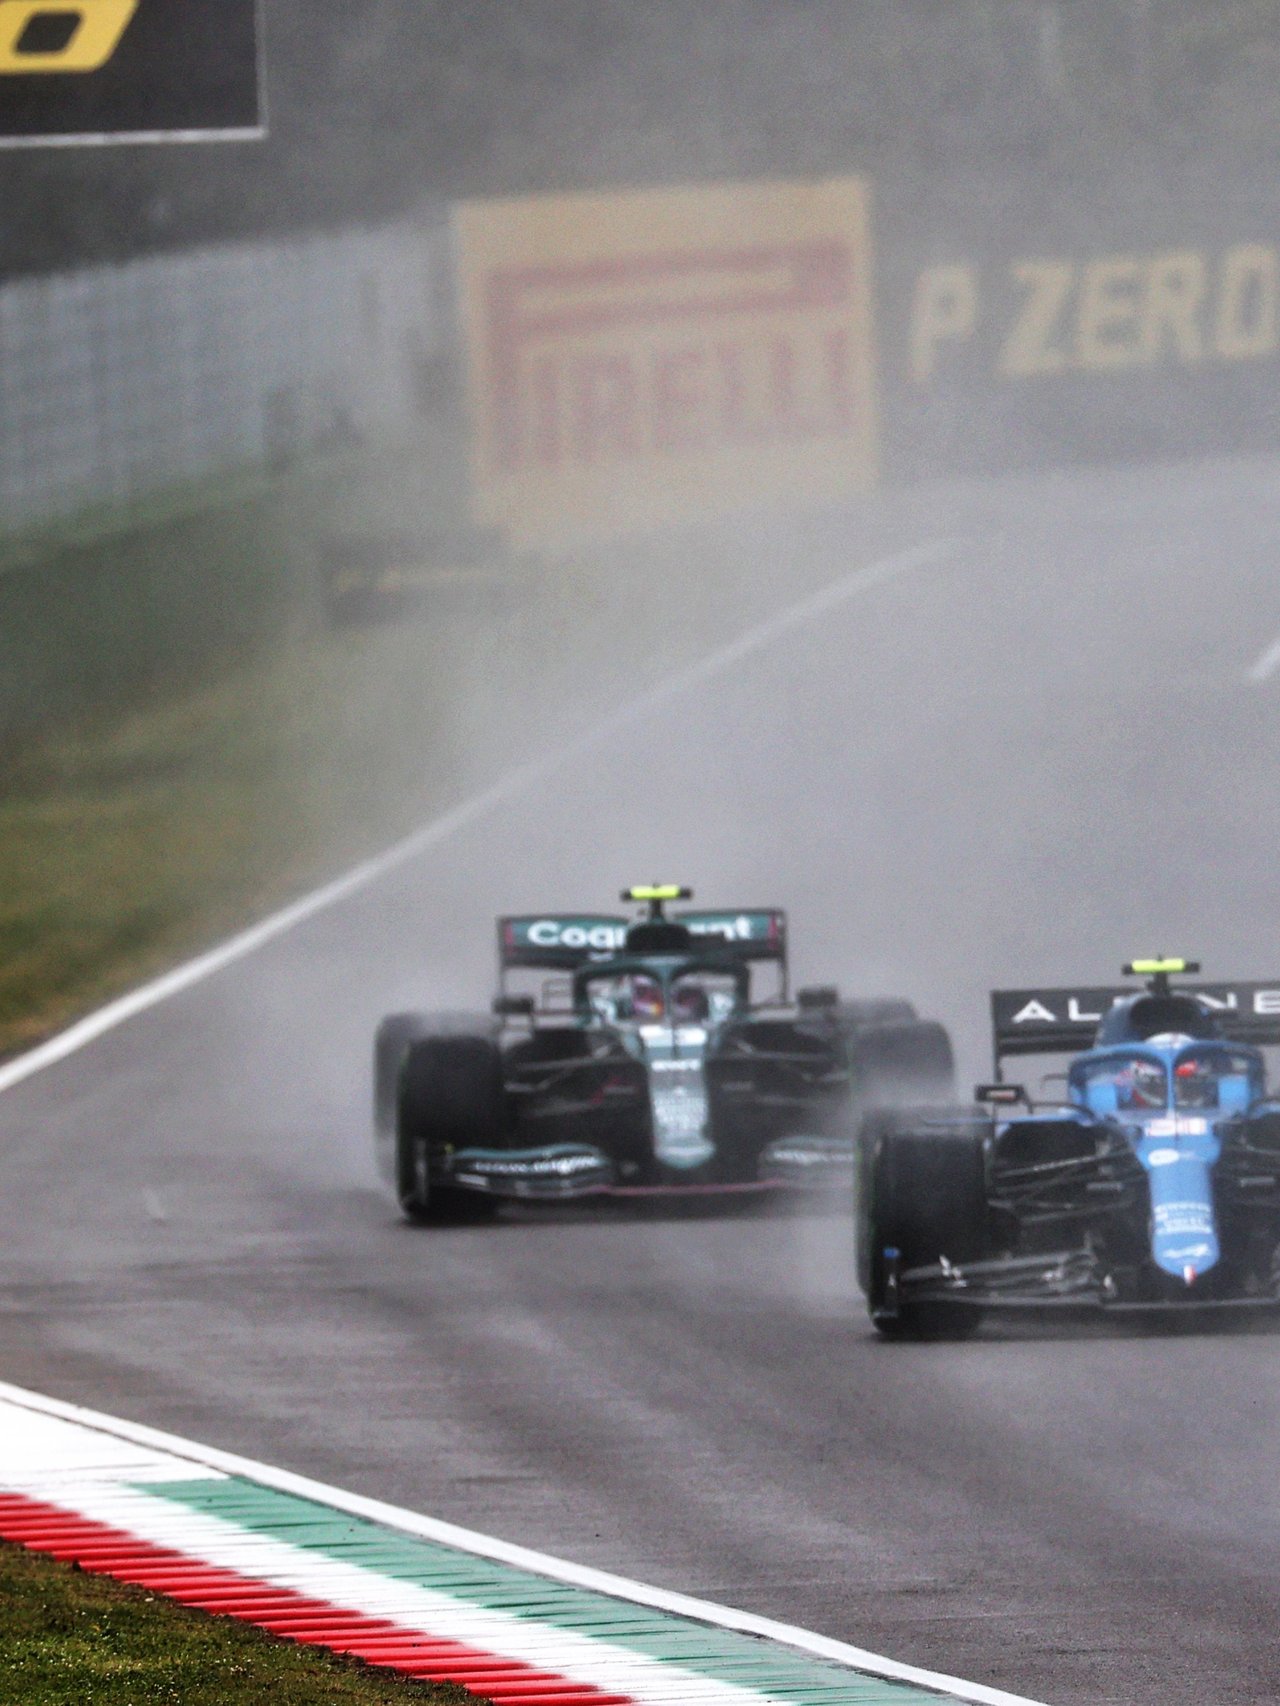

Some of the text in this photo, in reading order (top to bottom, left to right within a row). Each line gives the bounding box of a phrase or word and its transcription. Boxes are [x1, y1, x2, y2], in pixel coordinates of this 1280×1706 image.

[486, 236, 853, 470] PIRELLI
[907, 243, 1280, 380] P ZERO
